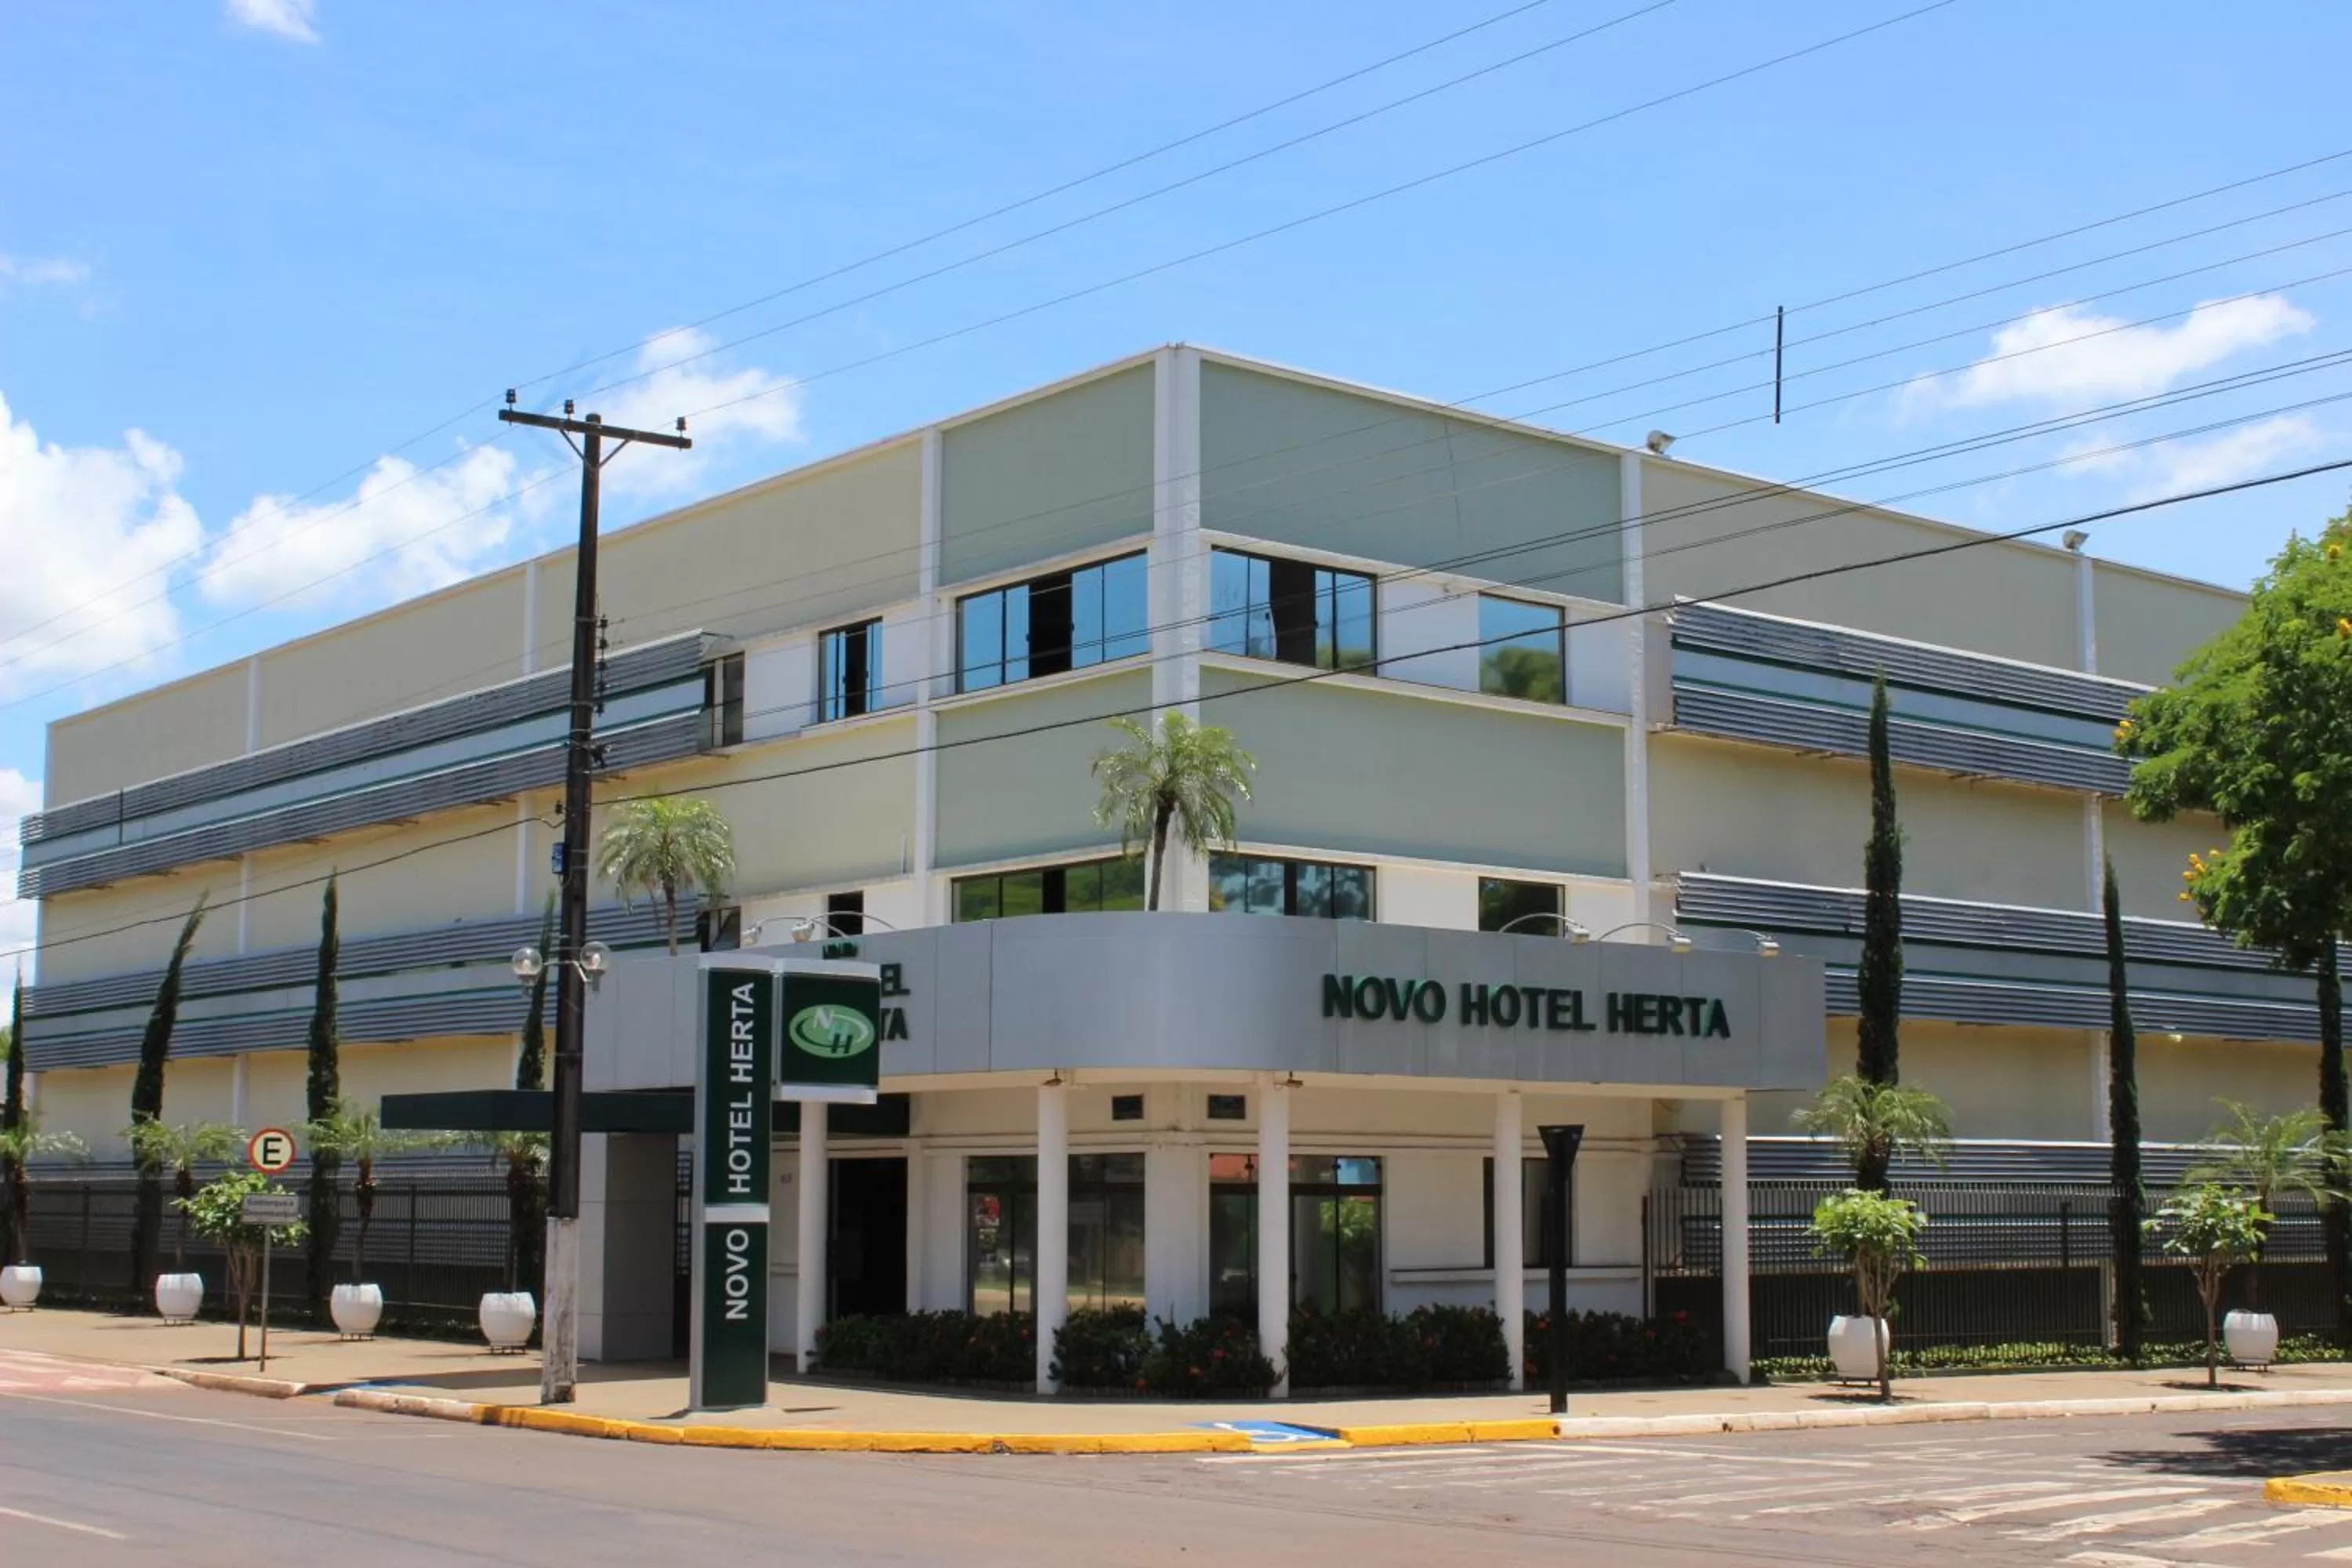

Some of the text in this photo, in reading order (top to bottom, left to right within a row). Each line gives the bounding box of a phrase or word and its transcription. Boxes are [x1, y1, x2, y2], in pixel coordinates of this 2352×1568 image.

[1323, 973, 1731, 1039] NOVO HOTEL HERTA
[263, 1137, 283, 1165] E
[726, 982, 755, 1320] NOVO HOTEL HERTA
